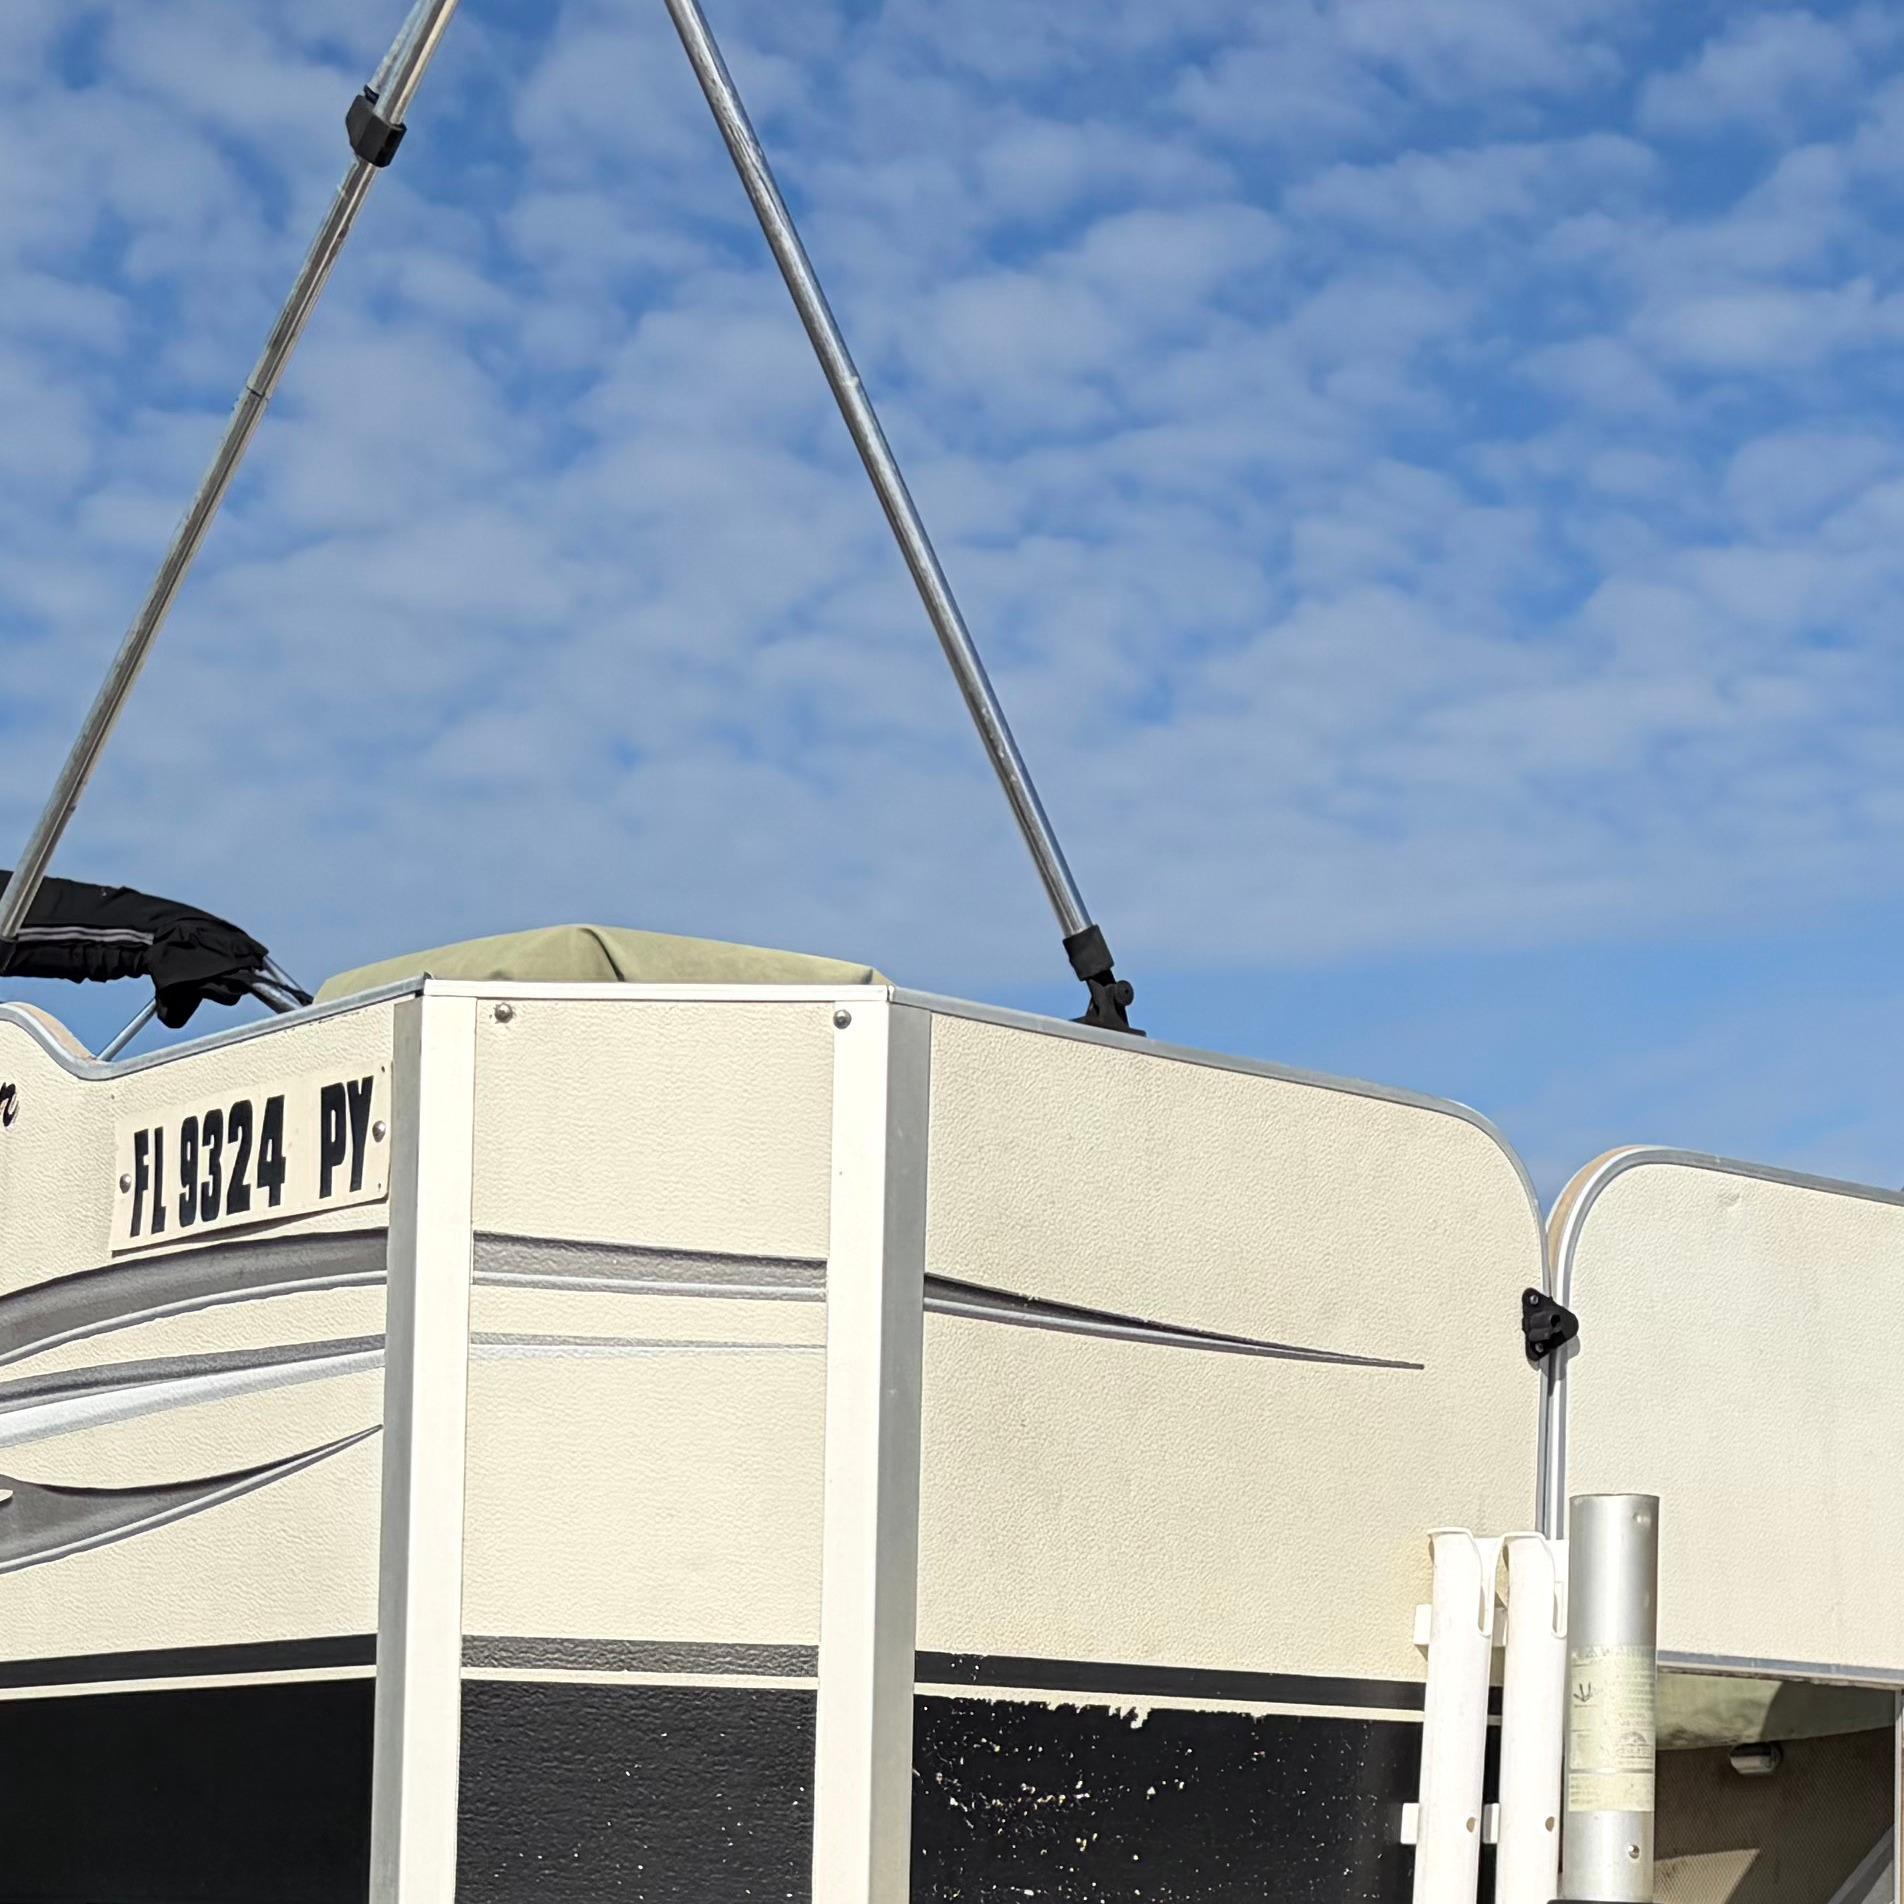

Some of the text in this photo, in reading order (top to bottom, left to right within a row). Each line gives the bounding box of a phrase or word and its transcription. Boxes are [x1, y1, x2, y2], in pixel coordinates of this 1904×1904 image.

[130, 1075, 374, 1238] FL 9324 PY
